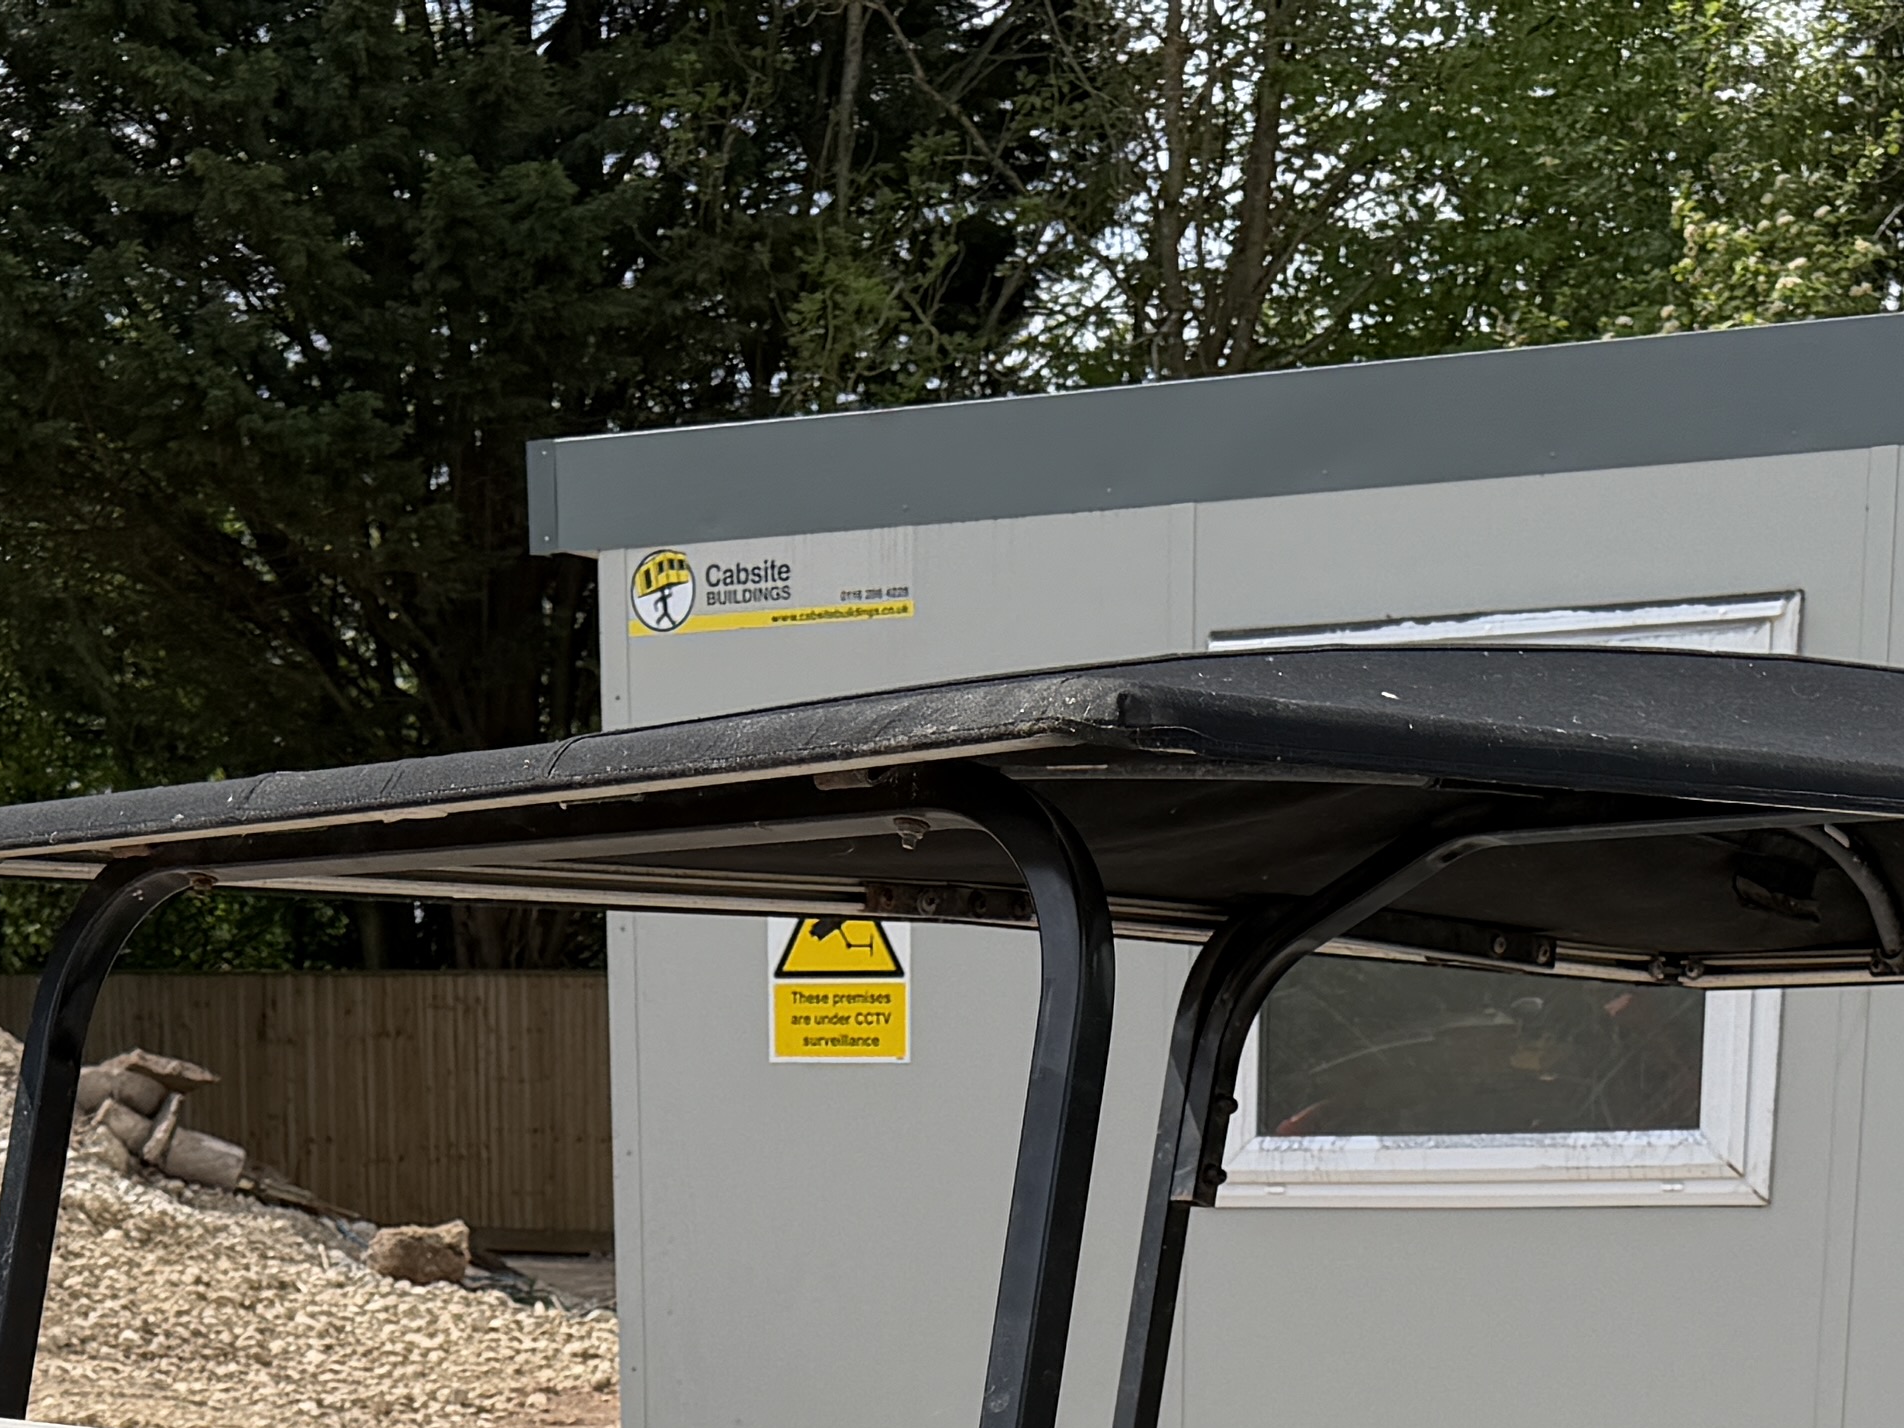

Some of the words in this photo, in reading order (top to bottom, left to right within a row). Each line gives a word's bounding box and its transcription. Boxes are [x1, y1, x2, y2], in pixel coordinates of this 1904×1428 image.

[705, 559, 791, 588] Cabsite
[705, 584, 792, 606] BUILDINGS
[791, 991, 829, 1004] These
[832, 990, 892, 1007] premises
[791, 1014, 811, 1025] are
[814, 1012, 851, 1025] under
[854, 1012, 892, 1026] CCTV
[802, 1034, 880, 1047] surveillance
